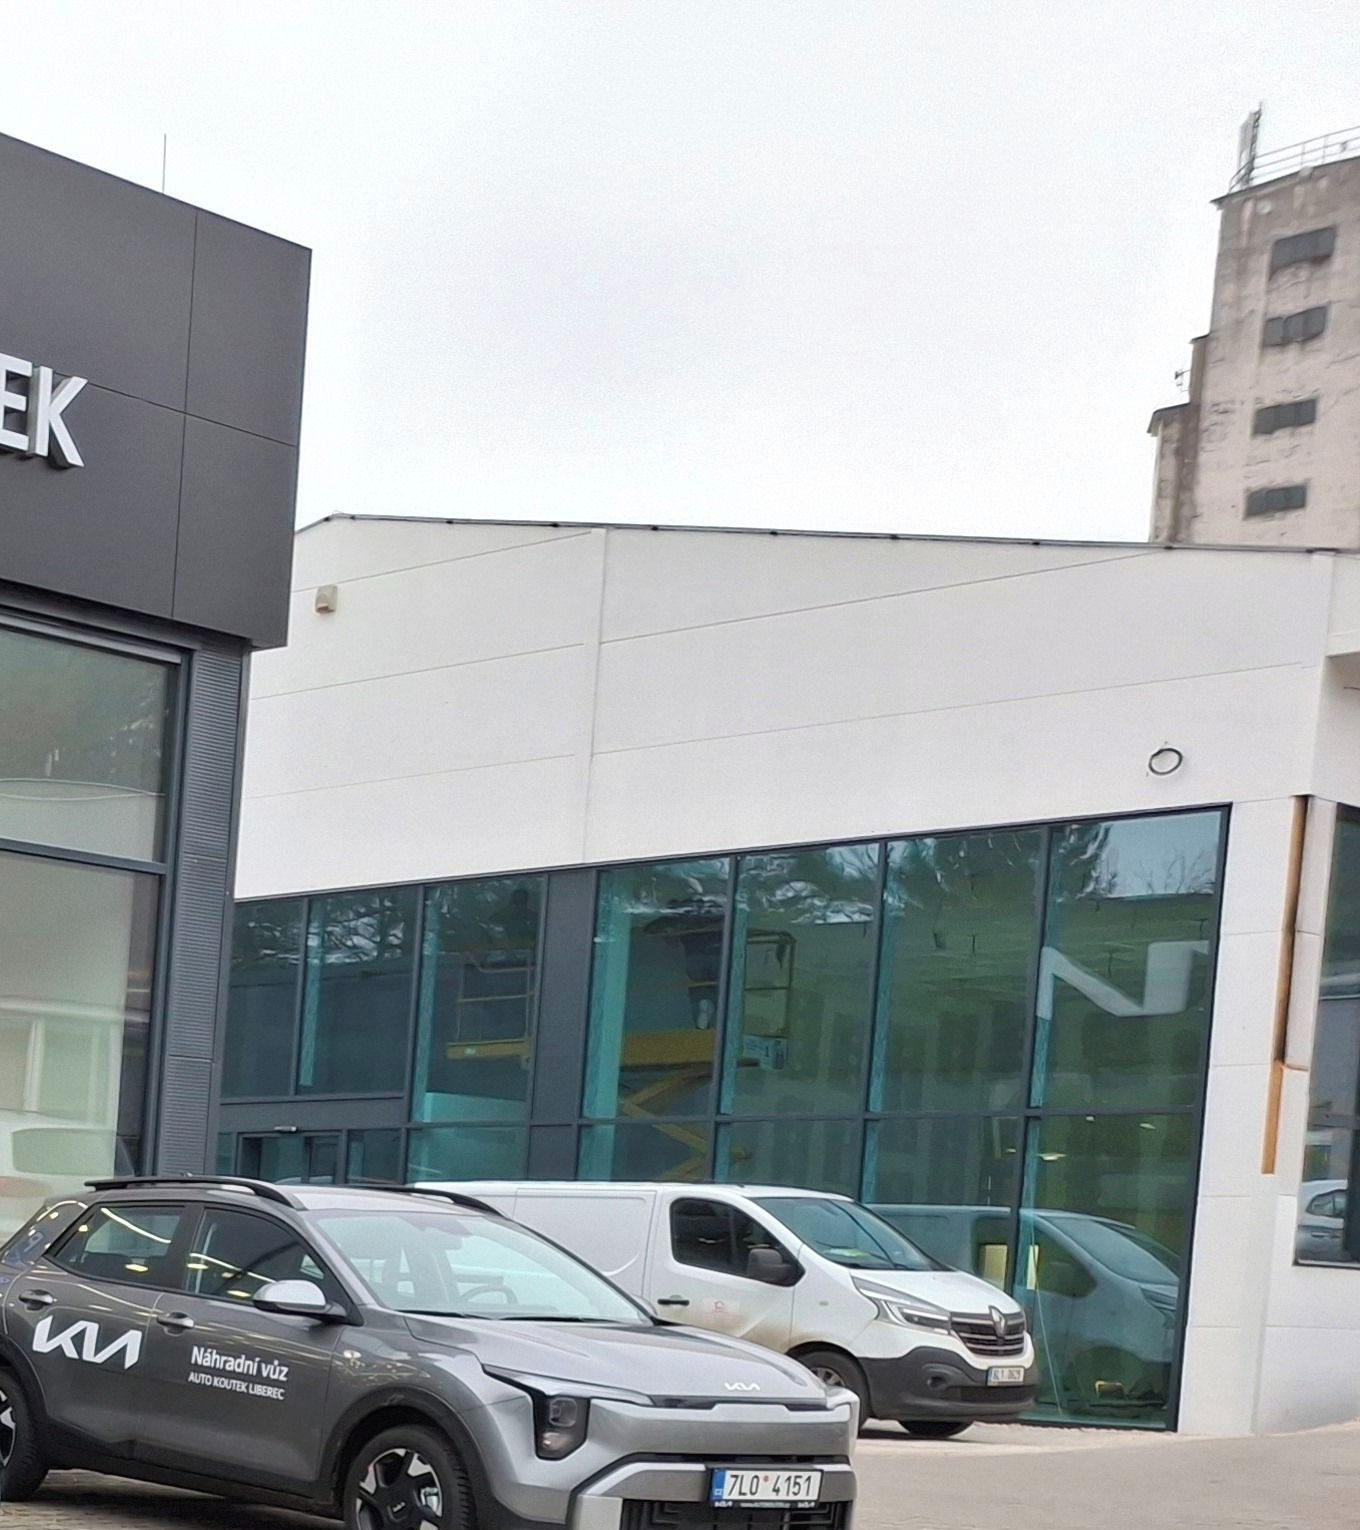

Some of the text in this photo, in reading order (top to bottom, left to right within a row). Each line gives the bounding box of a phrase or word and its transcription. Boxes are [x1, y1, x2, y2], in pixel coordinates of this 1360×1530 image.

[32, 1315, 142, 1370] KIA
[191, 1346, 289, 1381] Náhradní vůz
[188, 1372, 285, 1400] AUTO KOUTEK LIBEREC
[728, 1475, 760, 1496] 7L0
[772, 1475, 812, 1496] 4151
